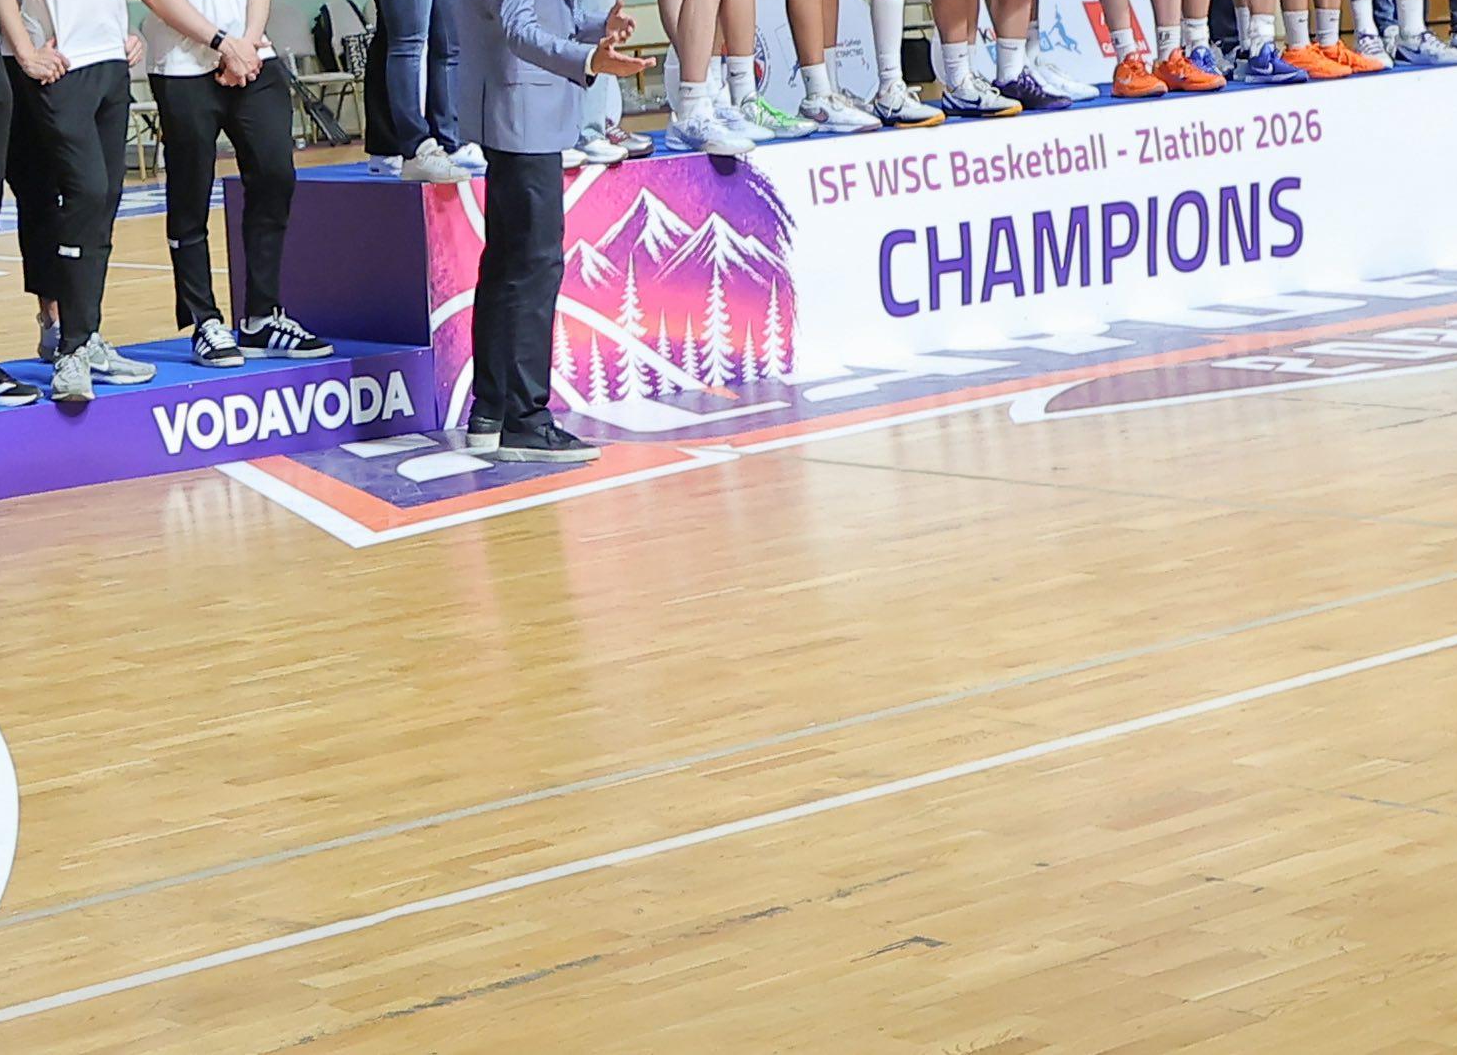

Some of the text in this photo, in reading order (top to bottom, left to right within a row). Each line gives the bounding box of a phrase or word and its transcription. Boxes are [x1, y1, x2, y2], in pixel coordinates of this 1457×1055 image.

[809, 162, 858, 206] ISF
[866, 151, 942, 201] WSC
[949, 132, 1109, 189] Basketball
[1135, 120, 1245, 167] Zlatibor
[1253, 108, 1323, 150] 2026
[878, 176, 1305, 318] CHAMPIONS
[152, 370, 416, 456] VODAVODA
